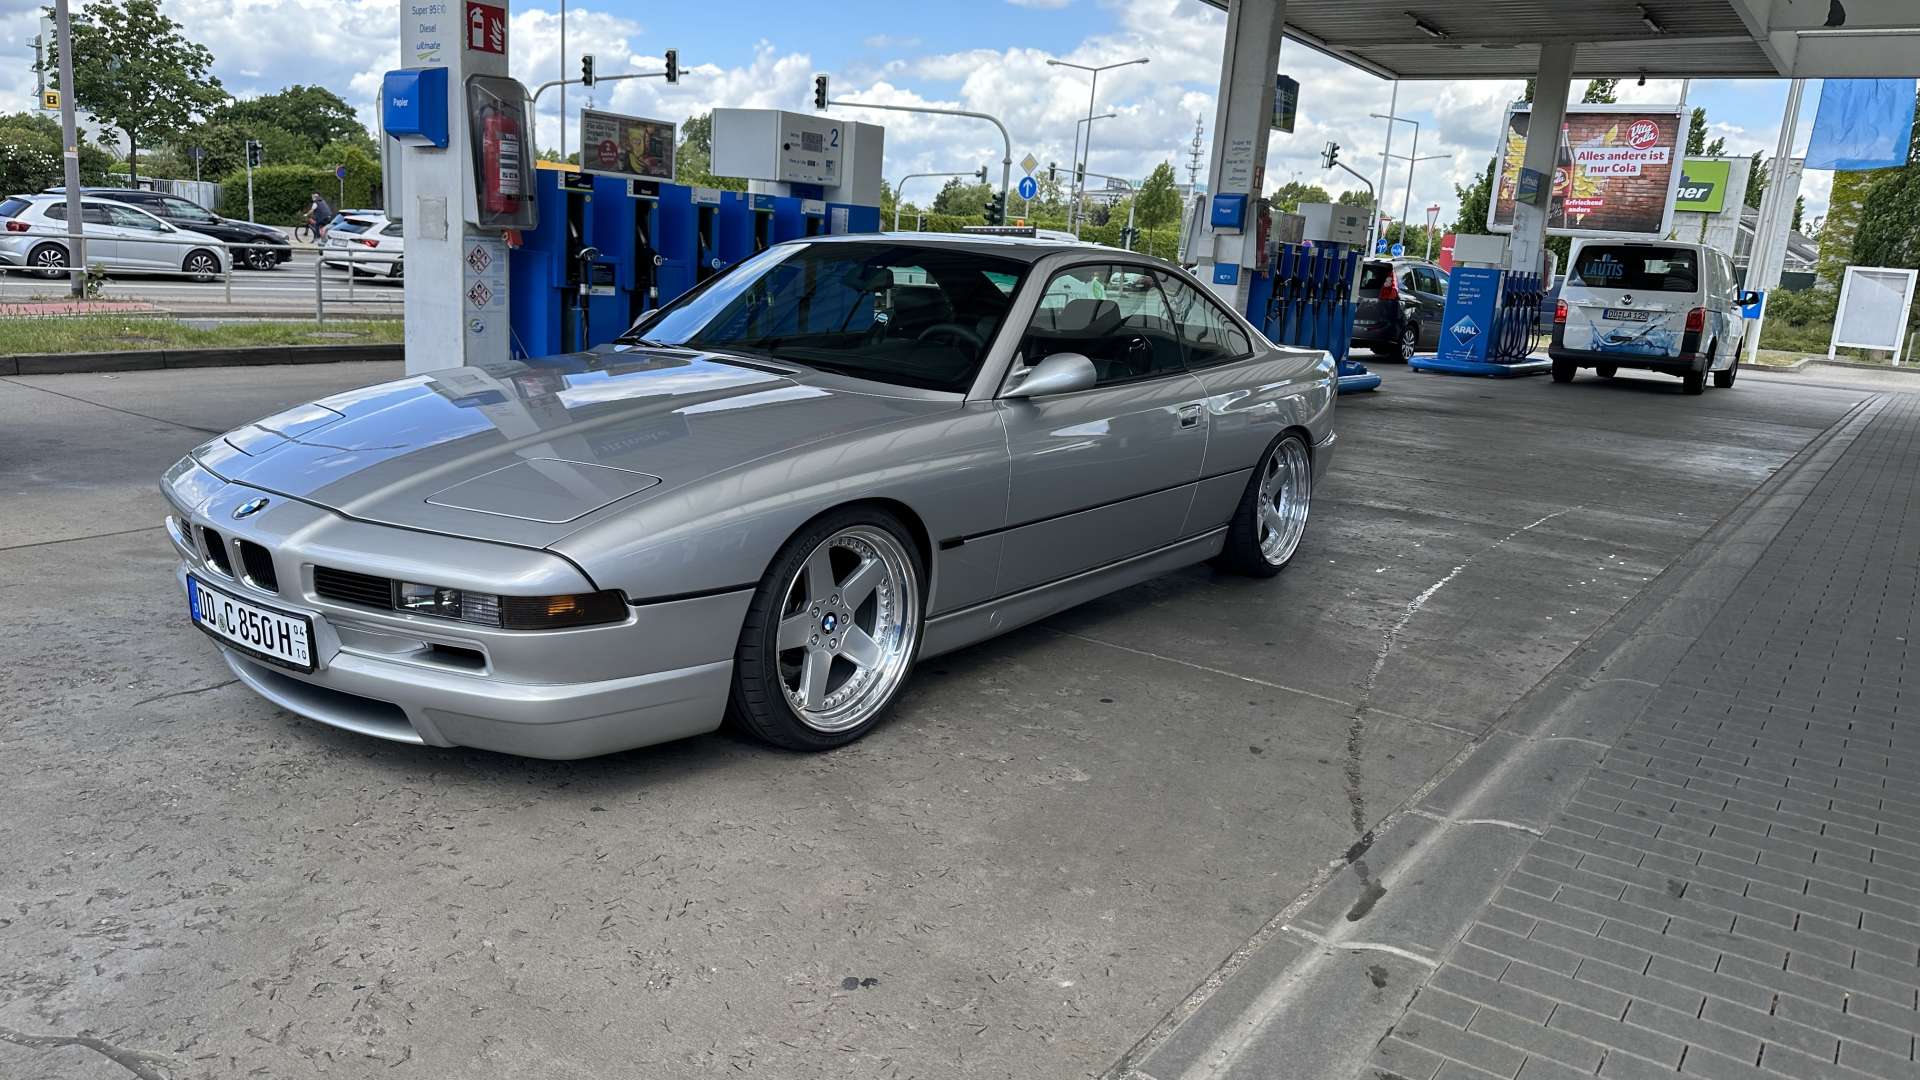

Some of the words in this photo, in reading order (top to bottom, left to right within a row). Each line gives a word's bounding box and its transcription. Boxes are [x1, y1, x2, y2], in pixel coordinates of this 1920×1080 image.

[412, 6, 428, 16] Super
[420, 24, 437, 33] Diesel
[393, 97, 409, 109] Papier
[1631, 124, 1653, 137] Vita
[830, 128, 839, 148] 2
[1631, 132, 1657, 146] Cola
[1578, 151, 1605, 160] Alles
[1607, 151, 1647, 160] andere
[1649, 151, 1665, 160] ist
[1590, 165, 1610, 173] nur
[1612, 163, 1637, 173] Cola
[1584, 262, 1624, 276] LAUTIS
[1453, 325, 1477, 335] ARAL
[198, 586, 217, 626] DD
